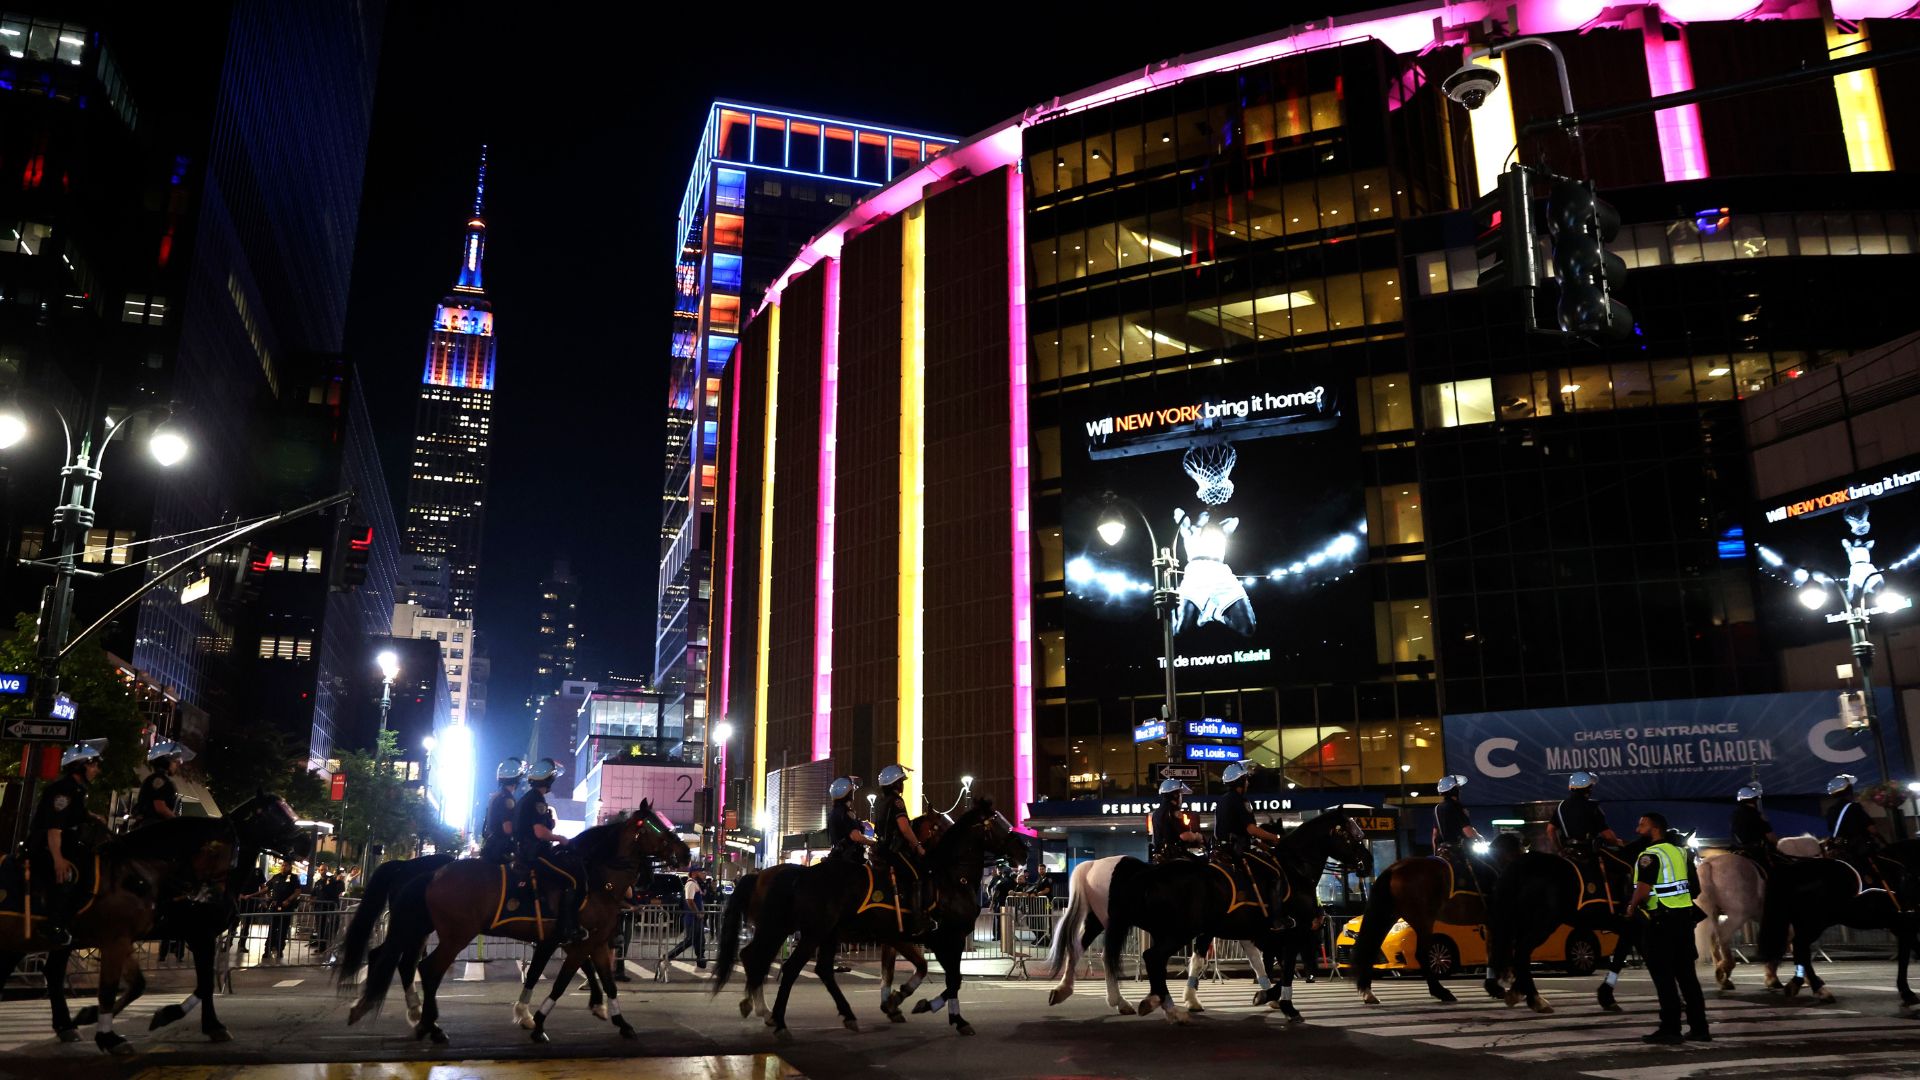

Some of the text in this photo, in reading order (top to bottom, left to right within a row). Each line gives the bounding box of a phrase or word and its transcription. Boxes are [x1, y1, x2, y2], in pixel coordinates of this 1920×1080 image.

[1086, 386, 1325, 437] Will NEW YORK bring it home?
[1766, 470, 1920, 523] Will NEW YORK bring it hom
[1157, 655, 1189, 669] Trde
[1190, 655, 1216, 667] now
[1216, 654, 1233, 664] on
[1189, 722, 1238, 736] Eighth Ave
[1574, 722, 1738, 742] CHASE ENTRANCE
[1190, 747, 1204, 758] Joe
[1205, 748, 1226, 759] Louis
[1474, 737, 1521, 778] C
[1545, 739, 1773, 771] MADISON SQUARE GARDEN
[676, 774, 693, 803] 2
